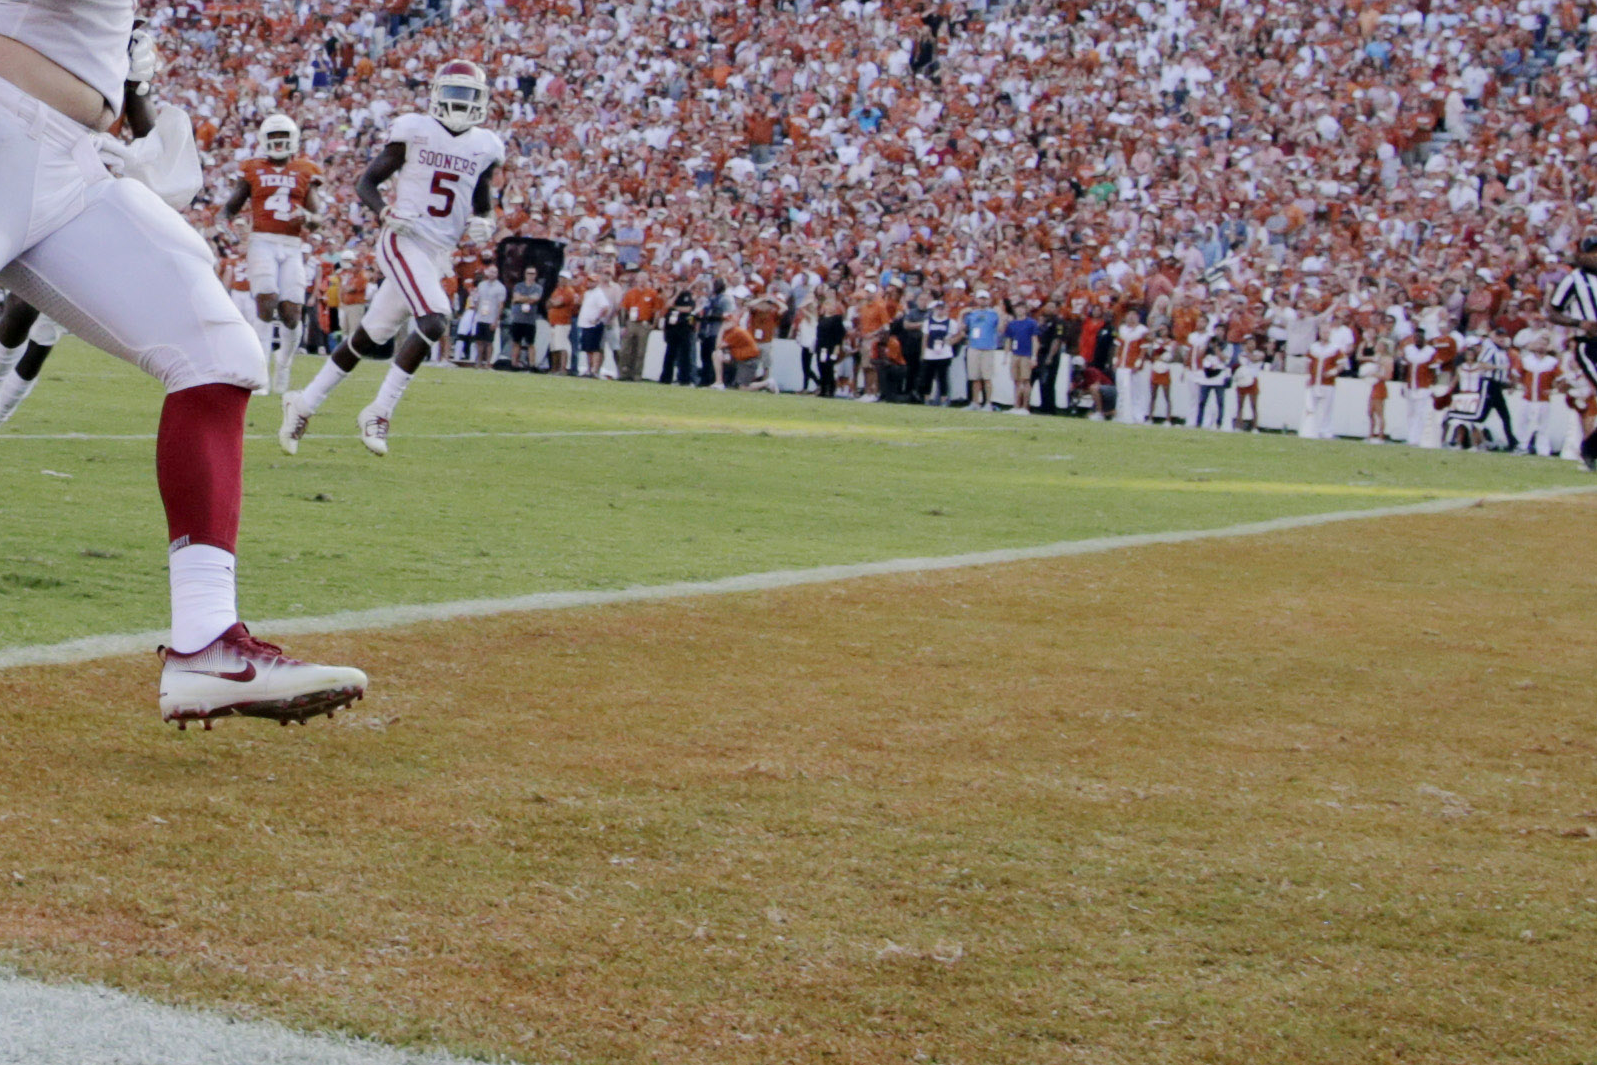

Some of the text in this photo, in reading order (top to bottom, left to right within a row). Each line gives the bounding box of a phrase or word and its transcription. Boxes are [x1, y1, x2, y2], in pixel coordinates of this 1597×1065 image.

[418, 149, 478, 176] SOONERS
[259, 174, 297, 188] TEXAS
[427, 171, 460, 218] 5
[264, 187, 292, 221] 4
